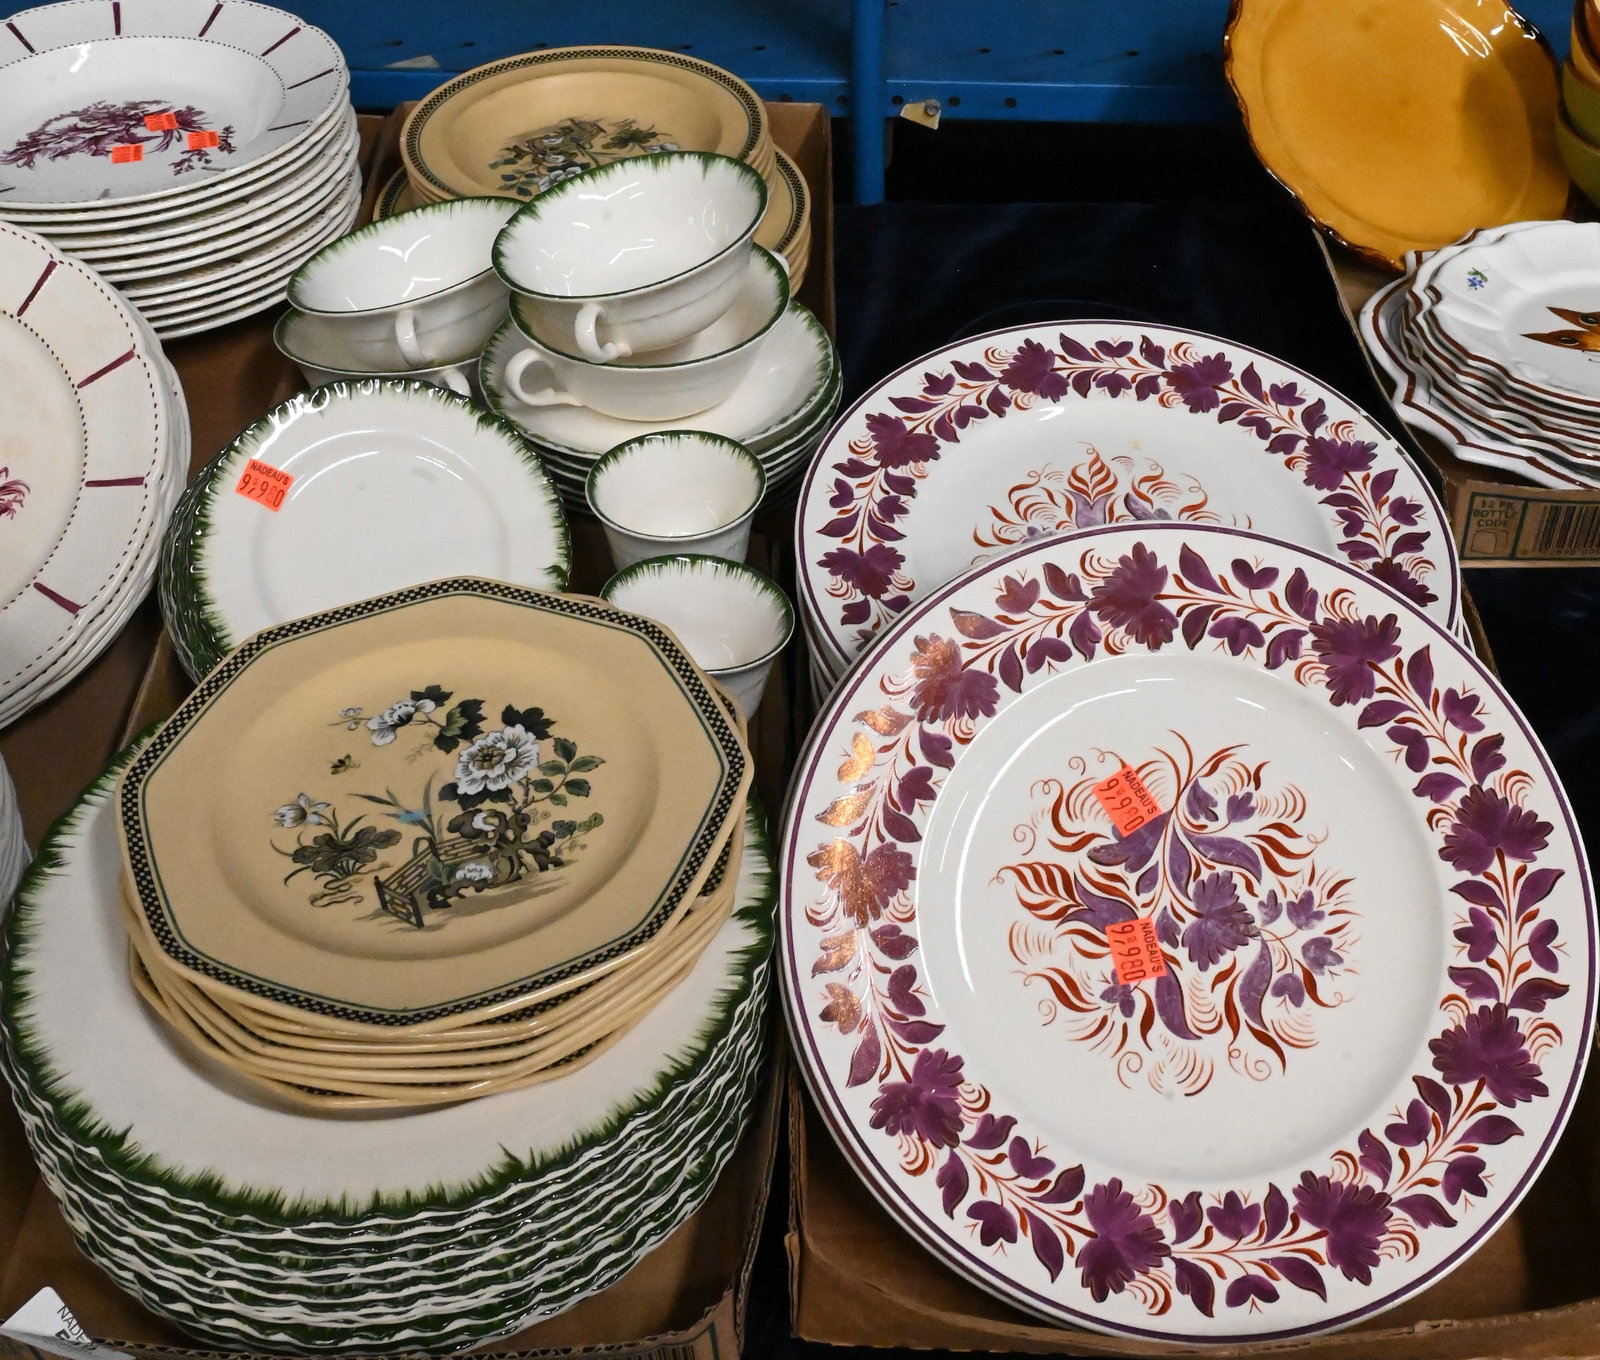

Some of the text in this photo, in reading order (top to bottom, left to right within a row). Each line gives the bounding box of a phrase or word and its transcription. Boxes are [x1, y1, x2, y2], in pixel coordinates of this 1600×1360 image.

[249, 462, 290, 486] NADEAU'S
[1480, 500, 1496, 509] 12
[1473, 509, 1519, 520] BOTTLE
[1477, 519, 1509, 528] CODE
[1122, 770, 1158, 815] NADEAU'S
[1139, 922, 1163, 973] NADEAU'S
